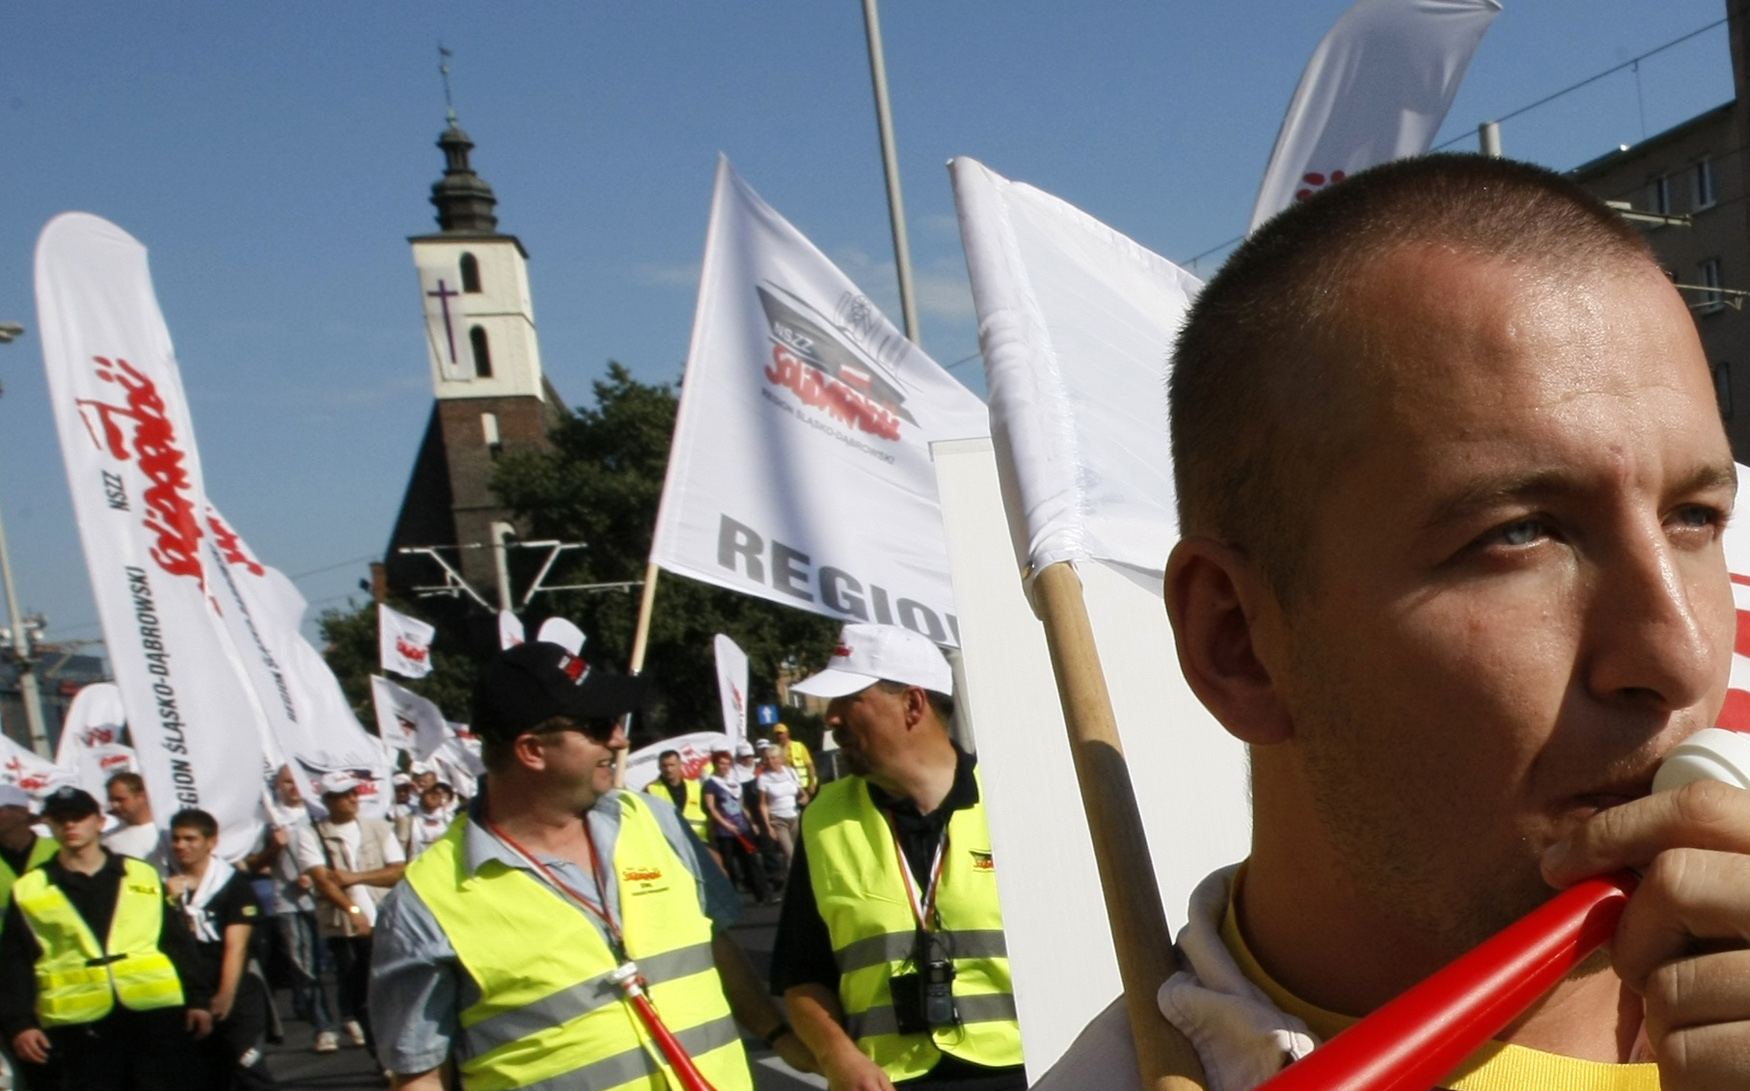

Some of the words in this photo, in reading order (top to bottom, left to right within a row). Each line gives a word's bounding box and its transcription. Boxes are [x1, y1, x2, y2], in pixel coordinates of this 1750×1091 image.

[774, 322, 814, 354] NSZZ
[102, 470, 131, 511] NSZZ
[124, 565, 189, 756] ŚLĄSKO-DĄBROWSKI
